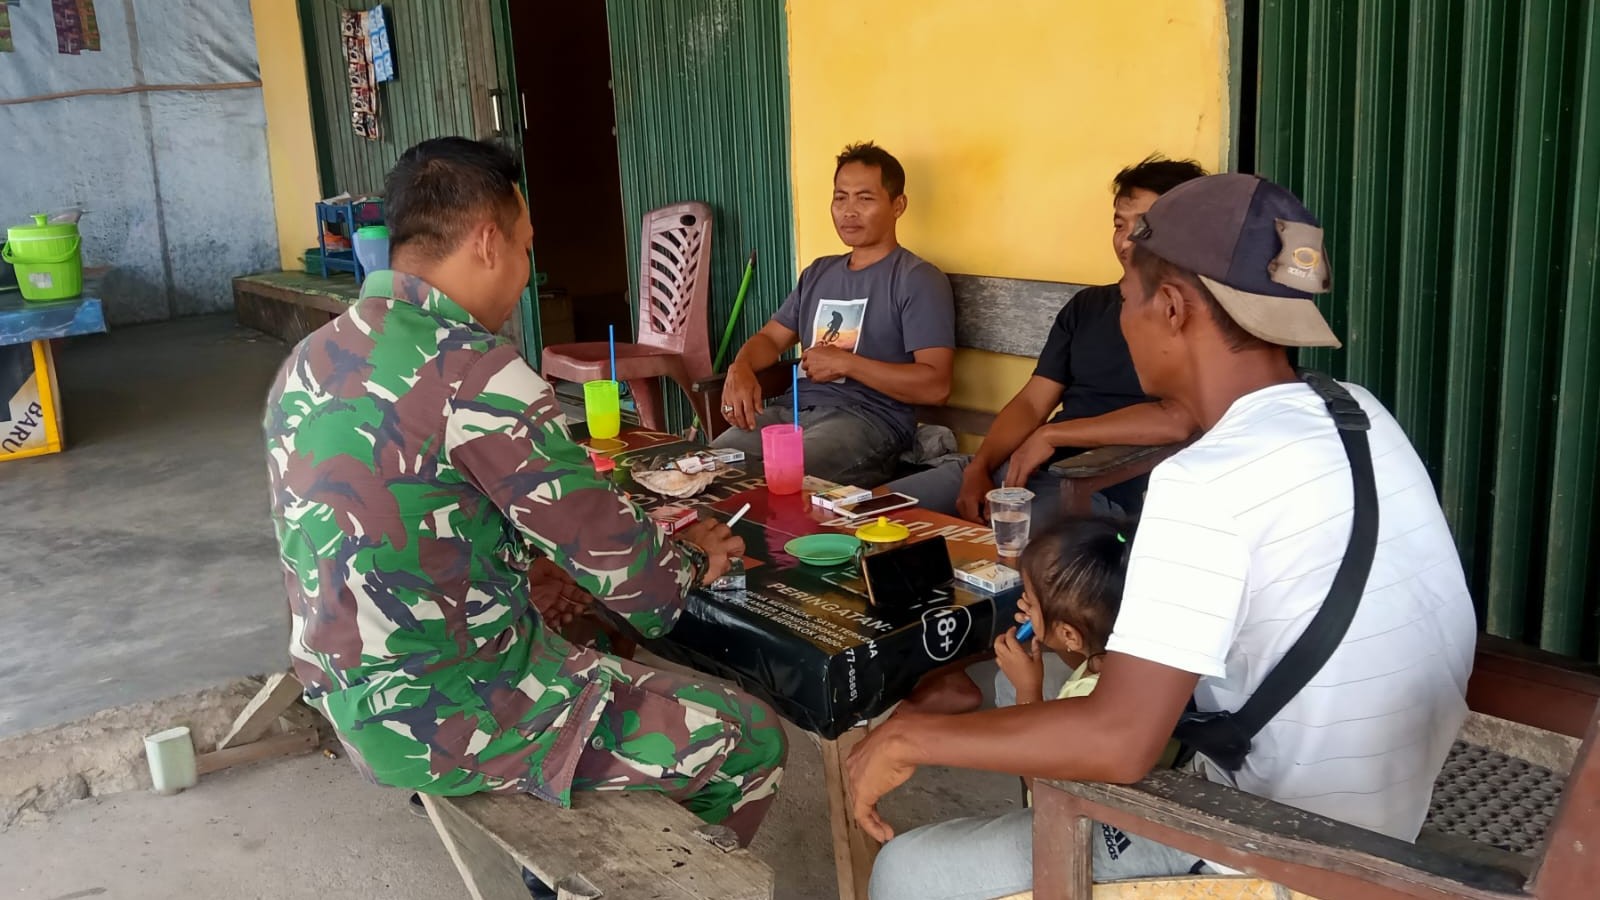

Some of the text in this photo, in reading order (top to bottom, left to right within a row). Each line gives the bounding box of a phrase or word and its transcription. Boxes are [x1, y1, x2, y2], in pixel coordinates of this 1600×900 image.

[2, 401, 43, 453] BARU
[766, 583, 893, 632] PERINGATAN:
[933, 608, 957, 652] 18+
[1102, 823, 1119, 860] adidas
